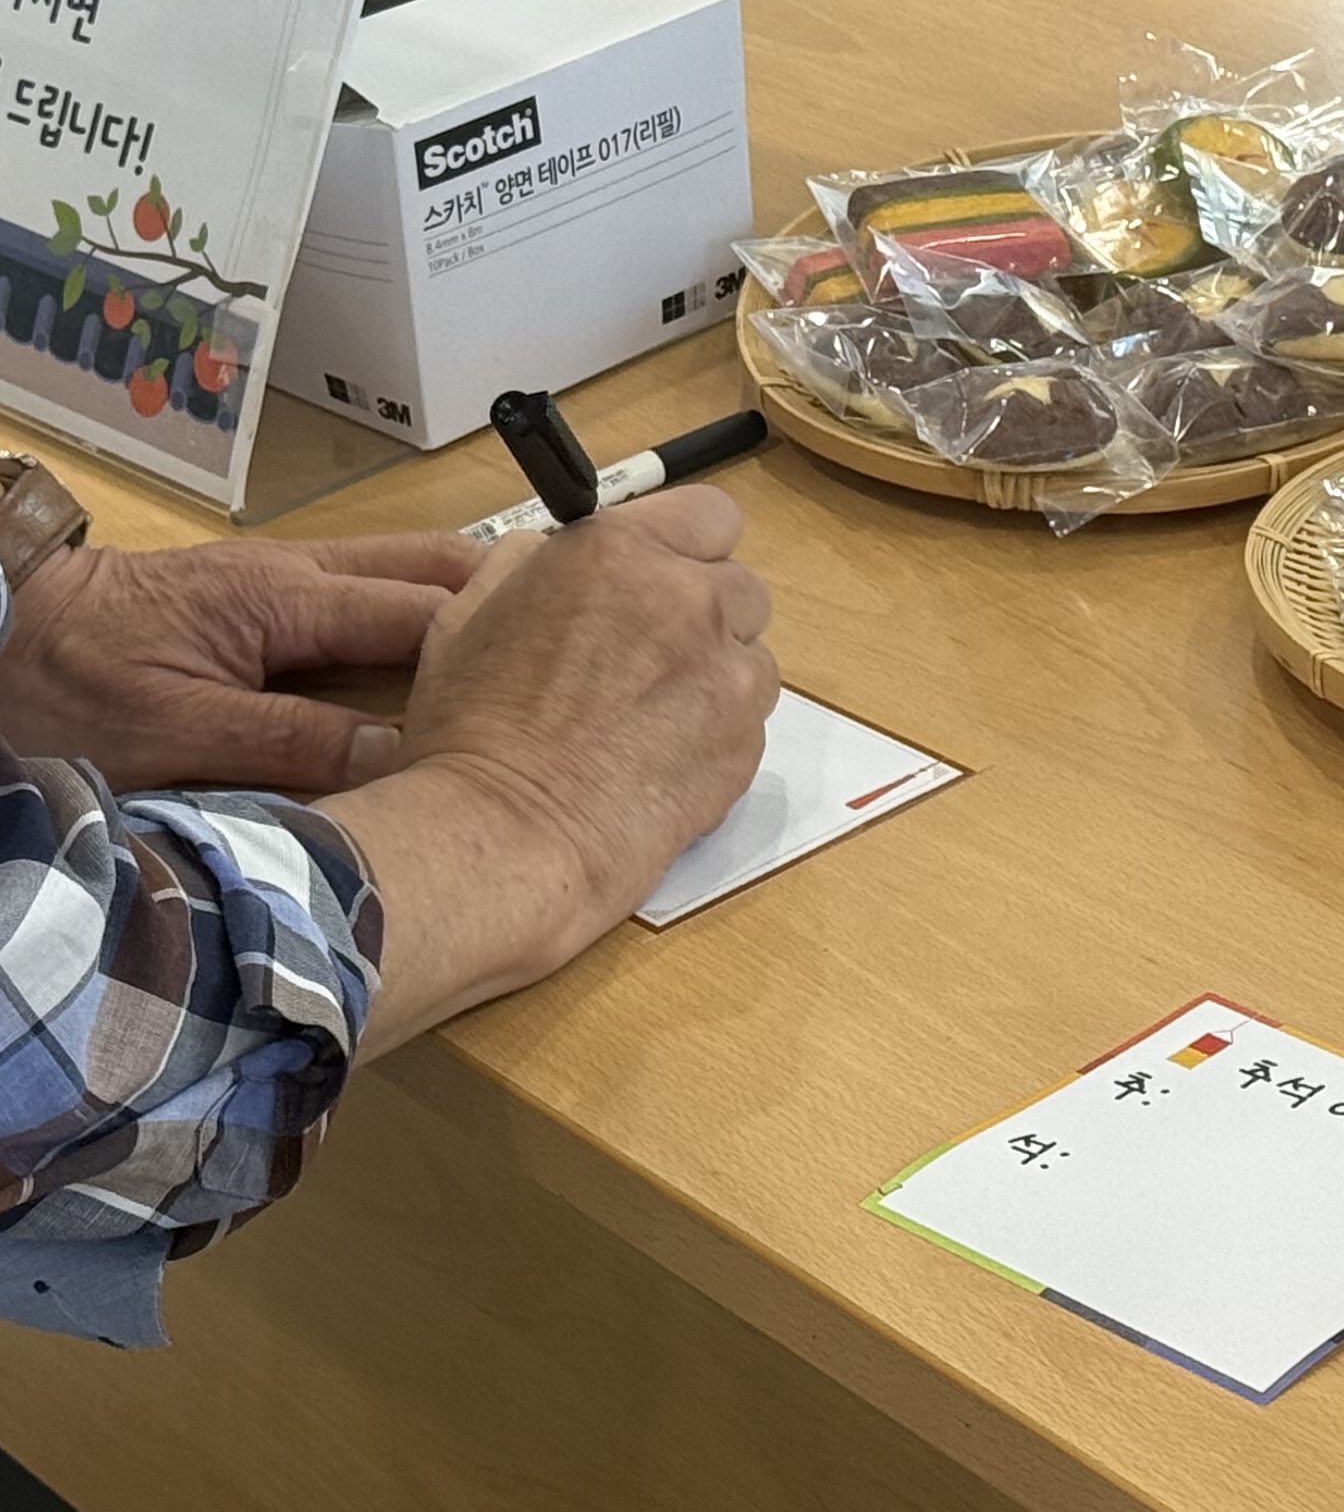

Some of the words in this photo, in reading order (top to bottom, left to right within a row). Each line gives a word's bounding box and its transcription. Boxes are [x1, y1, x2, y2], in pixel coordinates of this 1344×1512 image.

[7, 78, 156, 176] 드립니다!
[494, 166, 535, 206] 양면
[538, 144, 596, 186] 테이프
[376, 396, 412, 428] 3M
[1113, 1071, 1172, 1107] 추:
[1238, 1059, 1326, 1109] 추석
[1007, 1133, 1071, 1170] 석:
